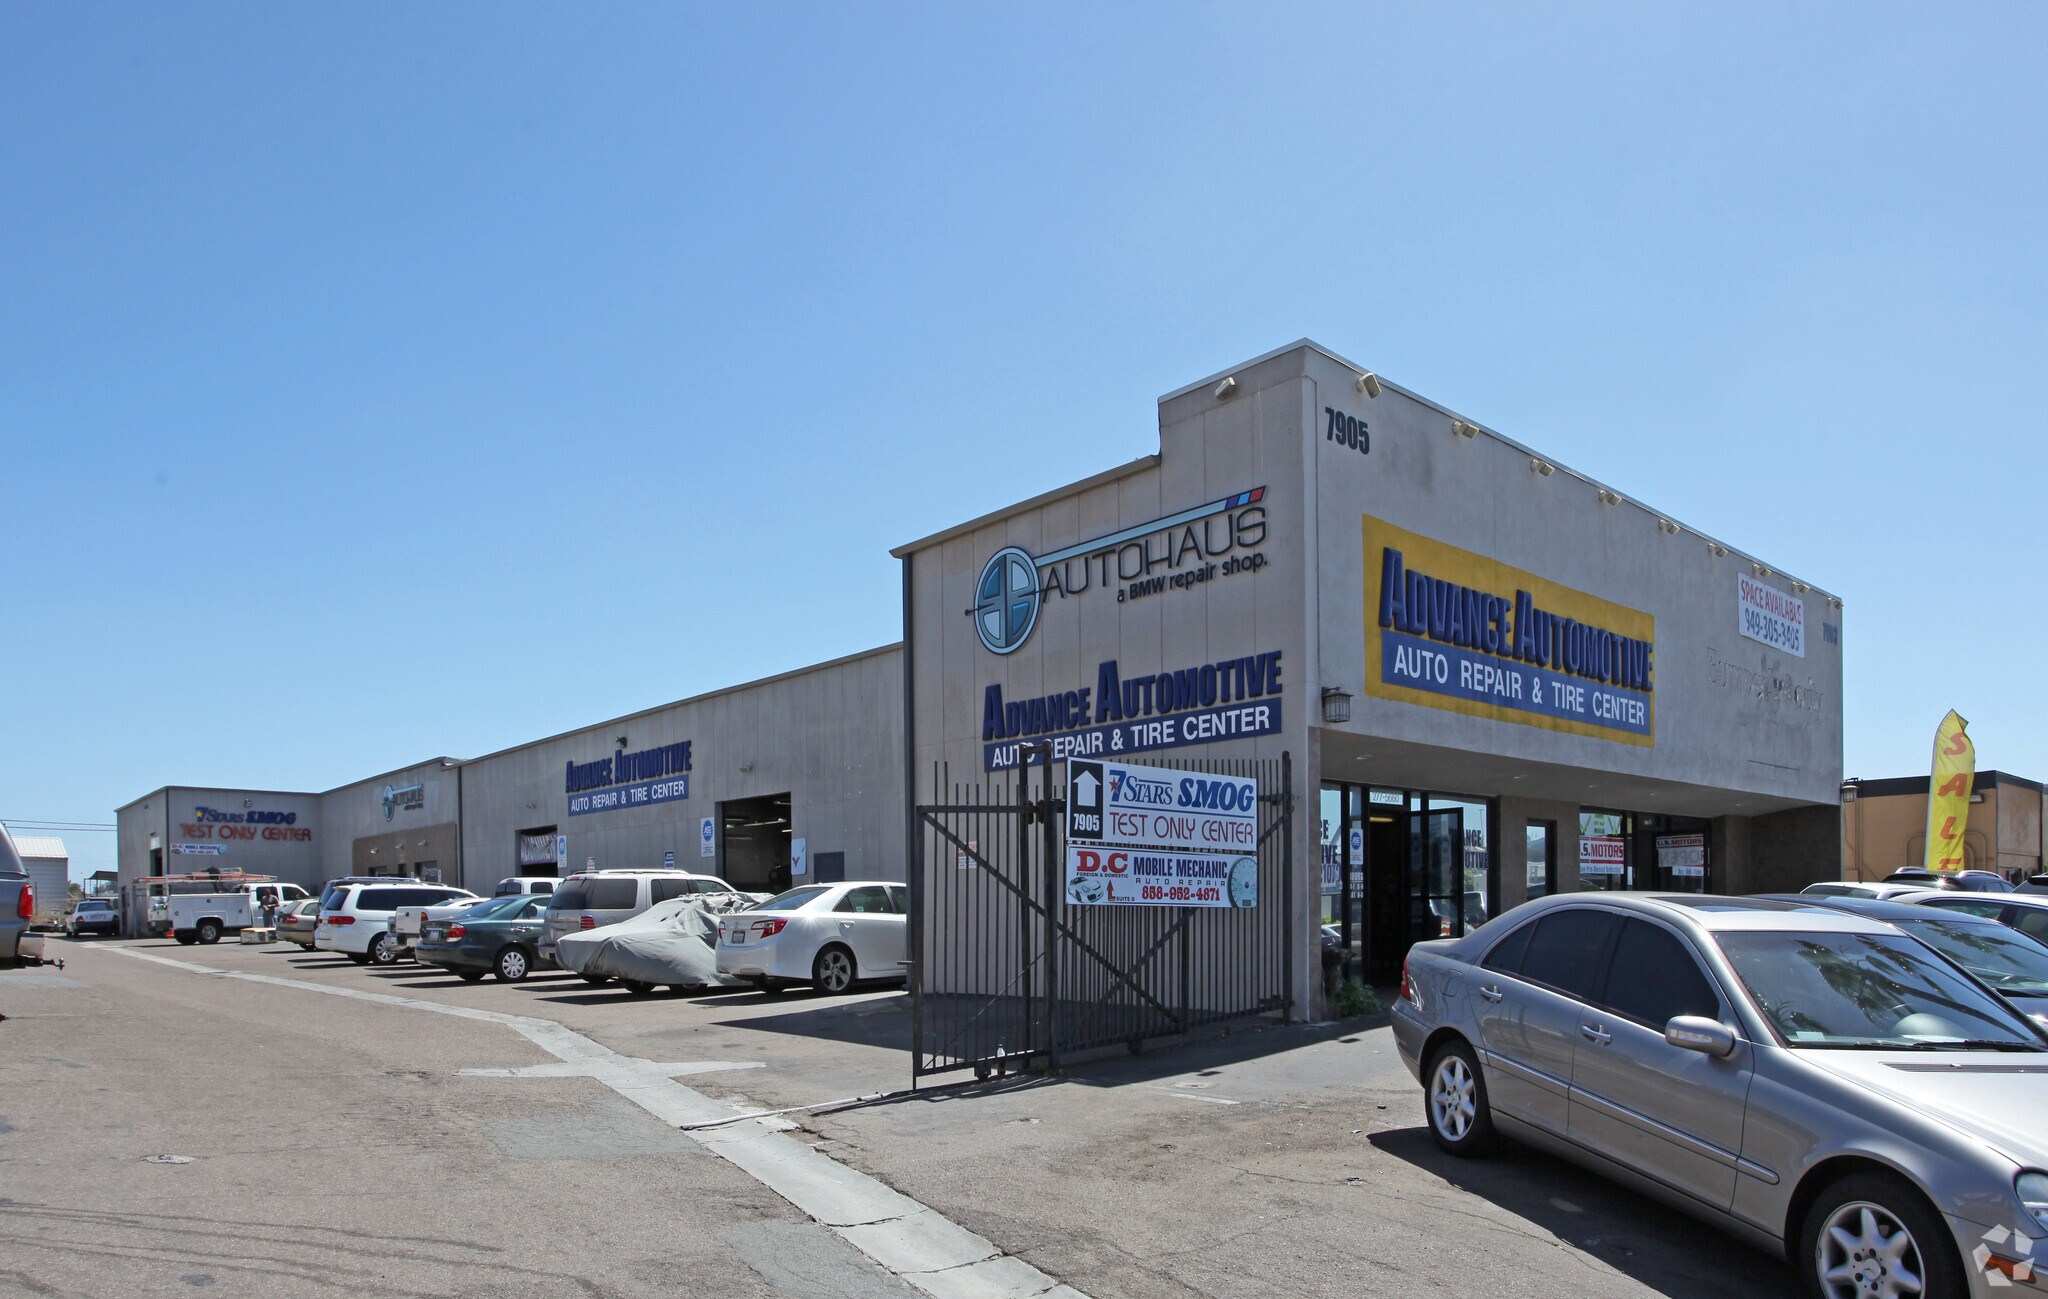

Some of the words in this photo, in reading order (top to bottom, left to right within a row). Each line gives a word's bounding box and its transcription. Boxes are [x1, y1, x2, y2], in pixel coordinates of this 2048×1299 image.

[1325, 406, 1370, 455] 7905
[1042, 506, 1267, 603] AUTOHAUS
[1117, 588, 1126, 603] a
[1129, 575, 1166, 600] BMW
[1169, 562, 1217, 590] repair
[1222, 552, 1268, 576] shop.
[1378, 546, 1515, 659] ADVANCE
[1512, 588, 1654, 693] AUTOMOTIVE
[1741, 579, 1764, 610] SPACE
[1765, 590, 1802, 625] AVAILABLE
[982, 683, 1092, 741] ADVANCE
[1095, 650, 1283, 724] AUTOMOTIVE
[1394, 645, 1449, 684] AUTO
[1460, 659, 1522, 700] REPAIR
[1532, 677, 1544, 704] &
[1552, 681, 1585, 714] TIRE
[1592, 691, 1645, 726] CENTER
[1050, 731, 1104, 759] EPAIR
[1111, 728, 1124, 750] &
[1130, 719, 1176, 748] TIRE
[1182, 705, 1271, 741] CENTER
[566, 757, 613, 794] ADVANCE
[614, 740, 693, 784] AUTOMOTIVE
[571, 797, 590, 812] AUTO
[592, 792, 618, 809] REPAIR
[621, 791, 627, 804] &
[630, 786, 648, 802] TIRE
[651, 780, 685, 799] CENTER
[1178, 777, 1255, 812] SMOG
[180, 824, 214, 839] TEST
[219, 825, 257, 840] ONLY
[262, 827, 311, 841] CENTER
[246, 810, 297, 825] SMOG
[1073, 813, 1101, 832] 7905
[1109, 812, 1149, 837] TEST
[1153, 815, 1197, 841] ONLY
[1201, 819, 1254, 844] CENTER
[1076, 851, 1129, 873] D.C
[1133, 857, 1173, 876] MOBILE
[1176, 859, 1228, 879] MECHANIC
[1142, 886, 1220, 901] 858-952-4871
[1179, 879, 1226, 887] REPAIR
